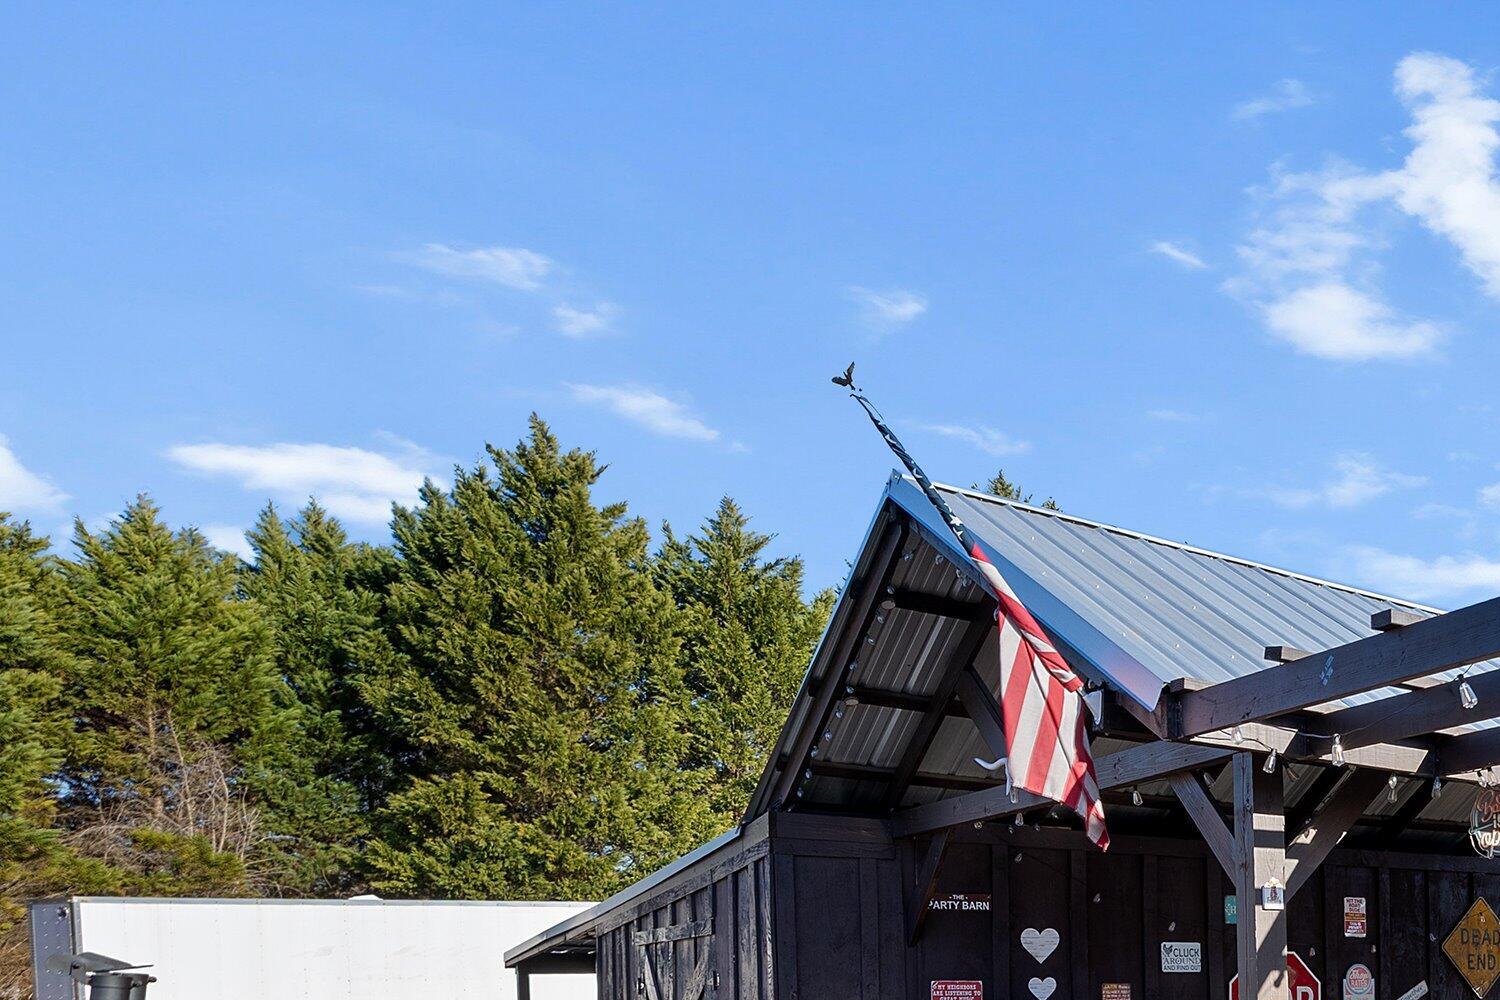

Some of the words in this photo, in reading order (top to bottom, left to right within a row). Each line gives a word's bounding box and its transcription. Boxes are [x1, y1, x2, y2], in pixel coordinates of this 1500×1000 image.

[962, 901, 990, 910] BARN
[1461, 928, 1500, 945] DEAD
[1173, 948, 1199, 957] CLUCK
[1467, 954, 1496, 970] END
